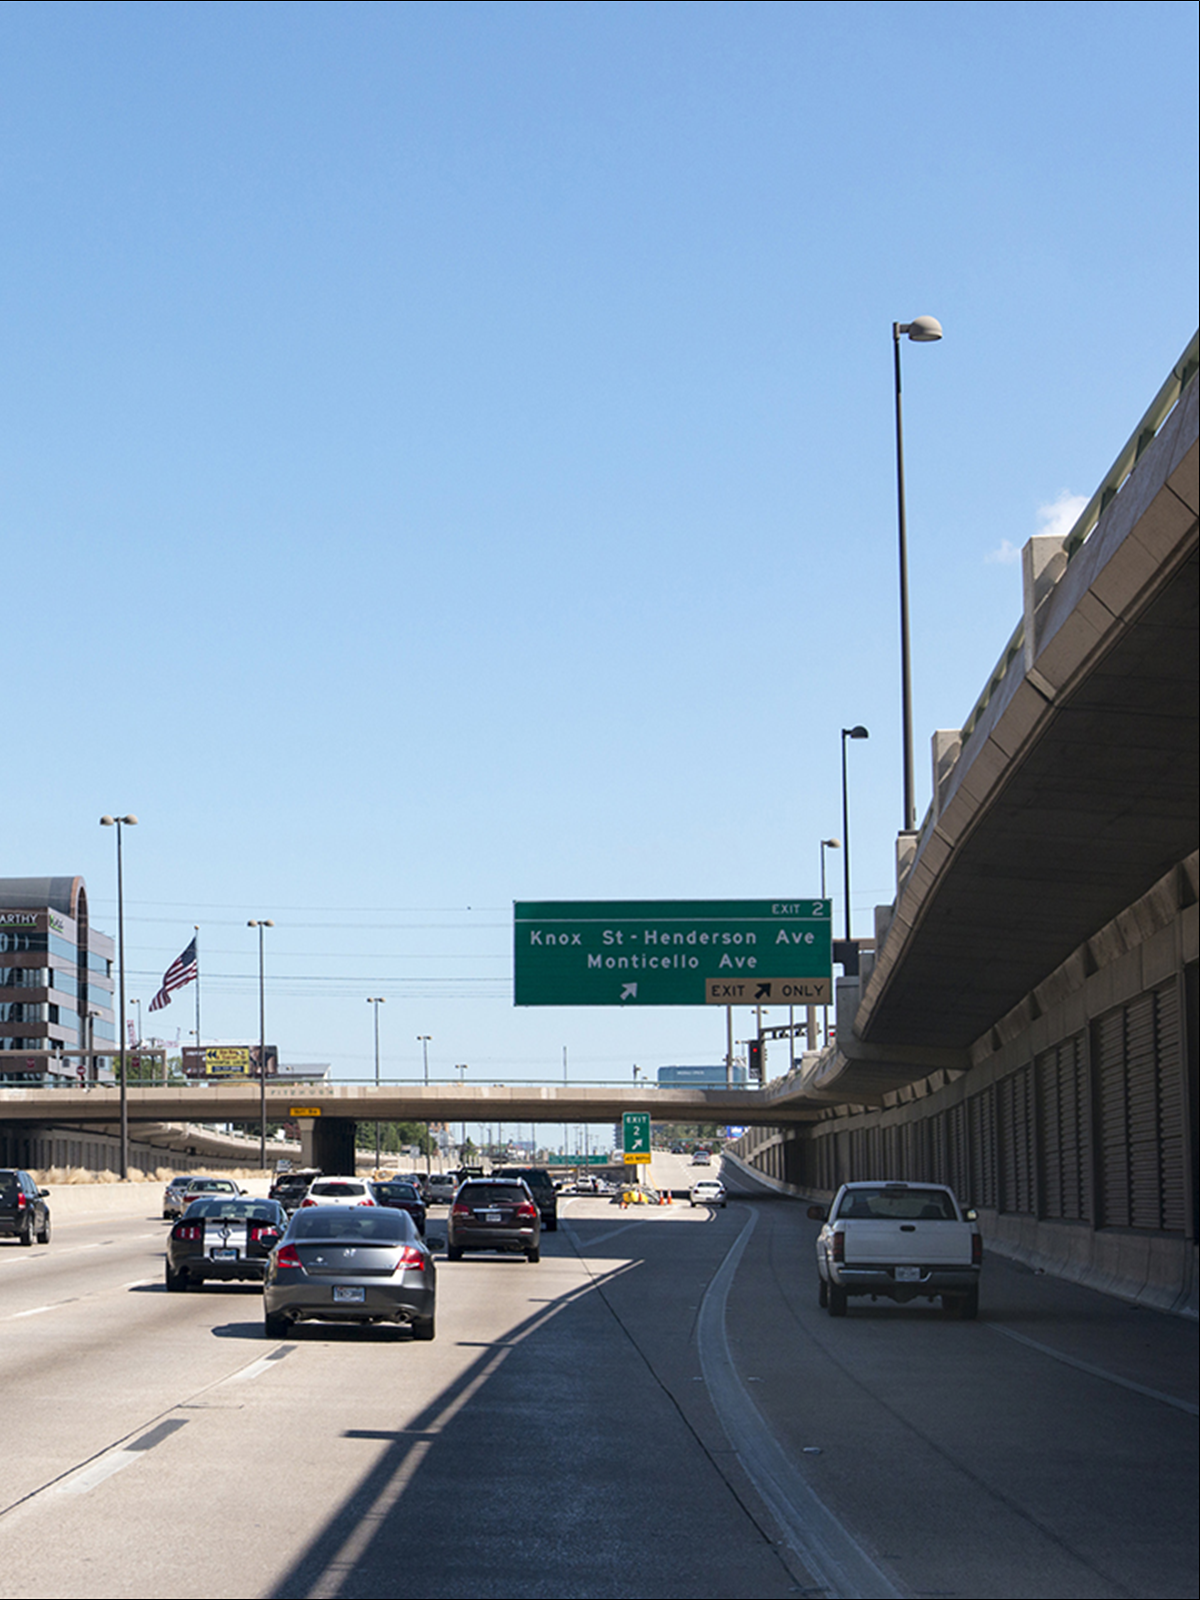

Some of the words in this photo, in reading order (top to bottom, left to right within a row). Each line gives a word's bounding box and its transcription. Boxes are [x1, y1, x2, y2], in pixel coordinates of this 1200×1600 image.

[771, 904, 800, 914] EXIT
[812, 902, 824, 916] 2
[530, 930, 582, 945] Knox
[775, 929, 815, 945] Ave
[587, 953, 699, 969] Monticello
[718, 953, 757, 969] Ave
[711, 984, 745, 997] EXIT
[782, 984, 825, 997] ONLY
[633, 1125, 640, 1136] 2
